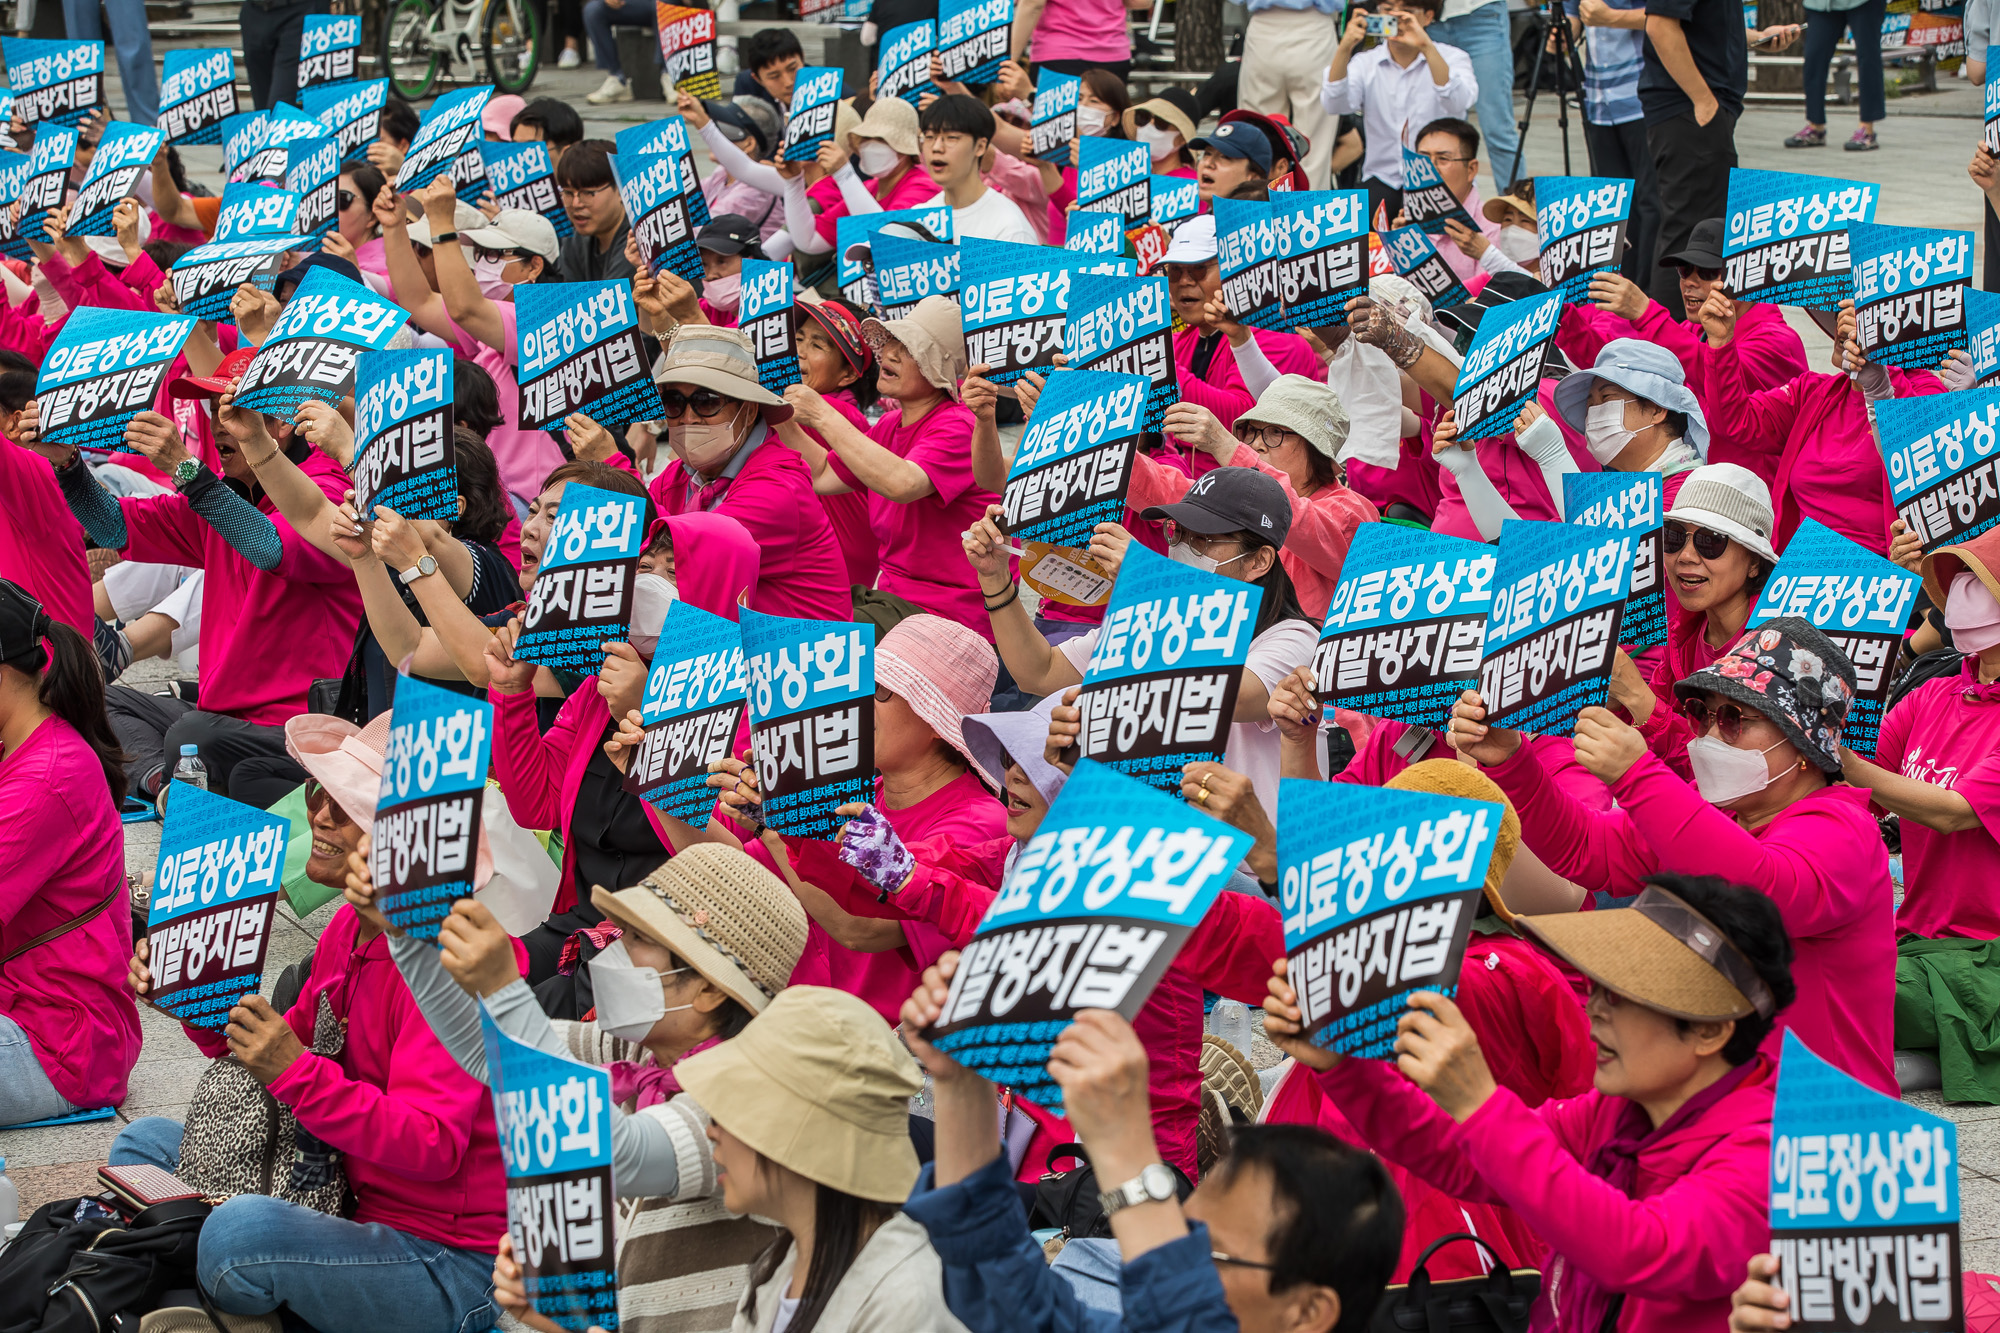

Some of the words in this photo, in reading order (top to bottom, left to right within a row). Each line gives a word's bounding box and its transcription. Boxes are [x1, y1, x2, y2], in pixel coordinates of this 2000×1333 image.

[940, 0, 1011, 47] 의료정상화
[940, 27, 1009, 77] 재발방지법
[9, 43, 100, 92] 의료정상화
[160, 51, 231, 109] 의료정상화
[1080, 146, 1148, 198] 의료정상화
[1729, 186, 1872, 248] 의료정상화
[172, 254, 276, 306] 재발방지법
[1852, 235, 1969, 302] 의료정상화
[42, 319, 191, 384] 의료정상화
[523, 283, 628, 374] 의료정상화
[1064, 281, 1165, 363] 의료정상화
[1459, 293, 1561, 387] 의료정상화
[38, 363, 166, 437] 재발방지법
[523, 334, 642, 424] 재발방지법
[1453, 342, 1547, 434] 재발방지법
[1015, 381, 1144, 467] 의료정상화
[1003, 442, 1129, 527] 재발방지법
[1487, 536, 1632, 645] 의료정상화
[1758, 575, 1913, 629] 의료정상화
[1311, 620, 1488, 693] 재발방지법
[1481, 609, 1615, 717] 재발방지법
[630, 707, 739, 786] 재발방지법
[154, 825, 284, 914] 의료정상화
[1284, 808, 1489, 935] 의료정상화
[150, 902, 268, 991] 재발방지법
[1772, 1123, 1950, 1221] 의료정상화
